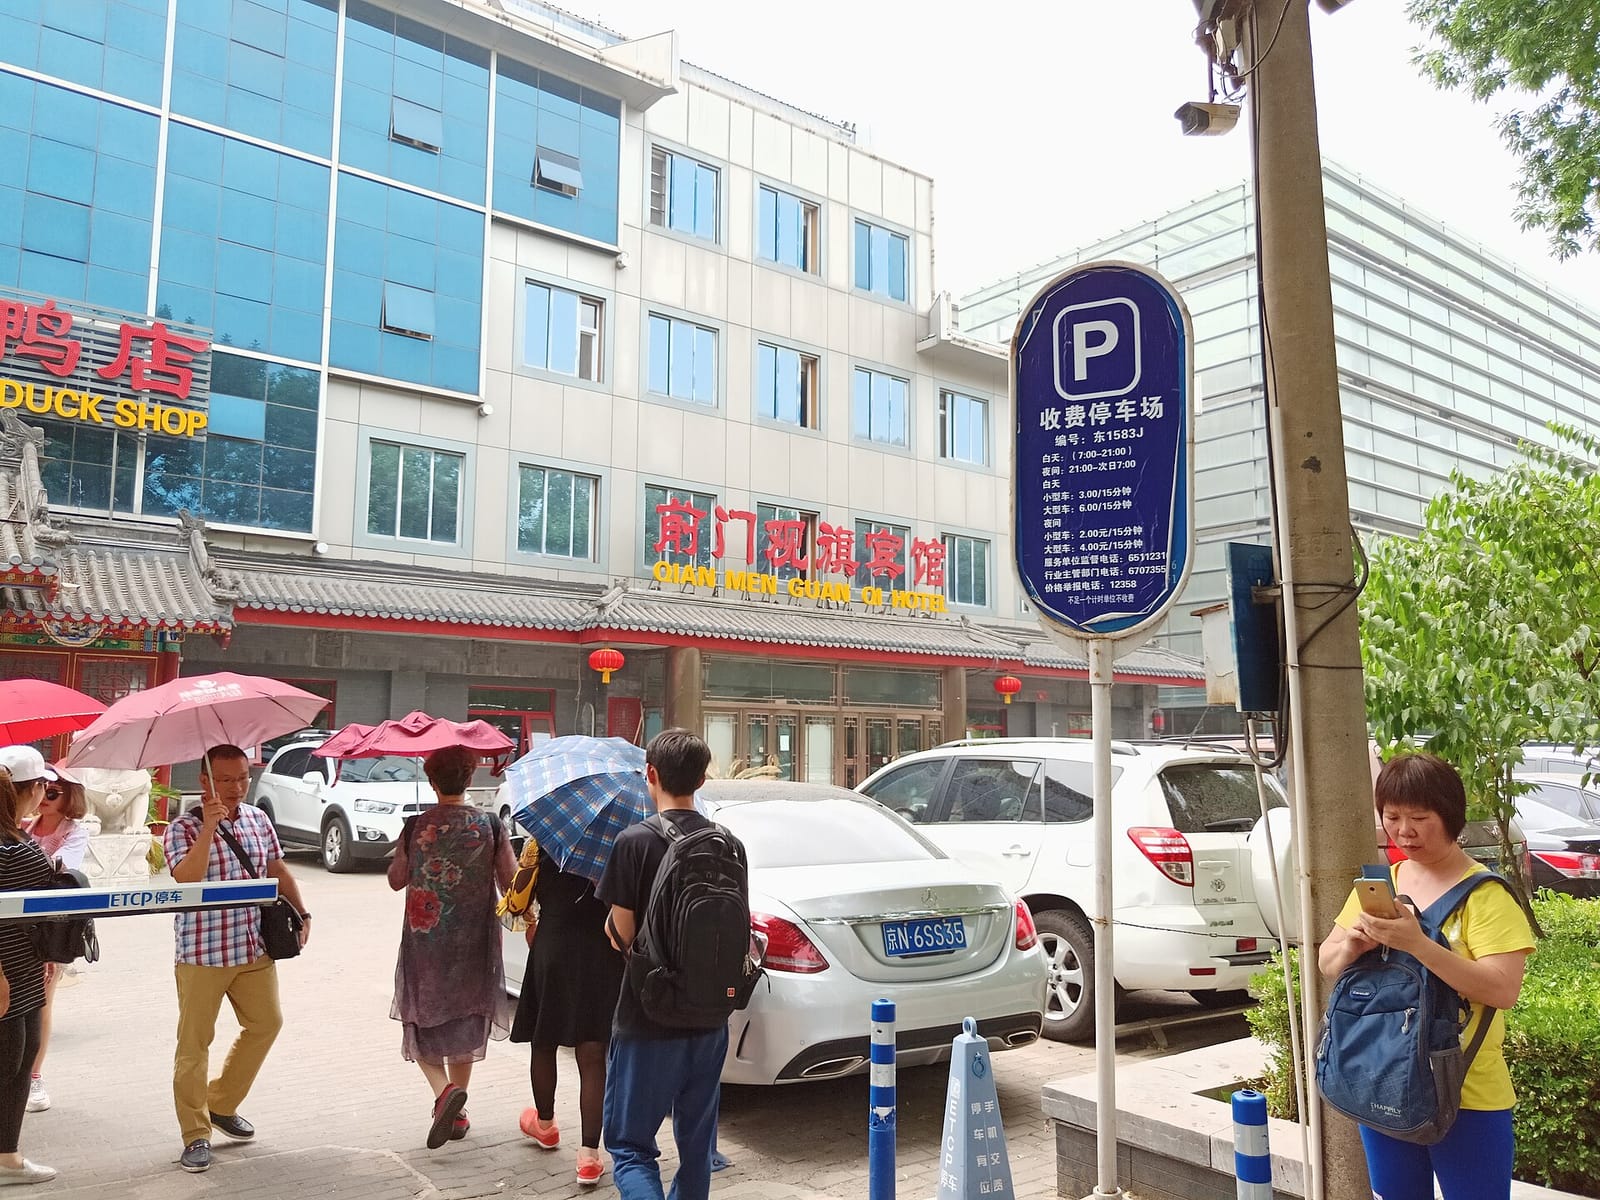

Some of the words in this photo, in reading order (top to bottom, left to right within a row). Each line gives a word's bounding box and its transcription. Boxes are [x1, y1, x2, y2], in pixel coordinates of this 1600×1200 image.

[0, 298, 209, 400] 鸭店
[1073, 319, 1119, 381] P
[0, 378, 104, 423] DUCK
[113, 399, 208, 437] SHOP
[1039, 395, 1164, 431] 收费停车场
[1054, 427, 1144, 447] 编号：东1583J
[1042, 480, 1060, 489] 白天
[1043, 518, 1061, 528] 夜间
[653, 497, 946, 587] 前门观旗宾馆
[1044, 552, 1168, 567] 服务单位监督电话：6511231
[653, 560, 716, 588] QIAN
[725, 570, 777, 595] MEN
[788, 577, 850, 602] GUAN
[861, 586, 882, 606] QI
[891, 590, 948, 613] HOTEL
[1045, 580, 1137, 593] 价格举报电话：12358
[1067, 594, 1135, 605] 不足一个计时单位不收费
[110, 892, 153, 907] ETCP
[155, 891, 183, 904] 停车
[886, 922, 964, 951] 京N·6SS35
[945, 1100, 958, 1168] ETCP
